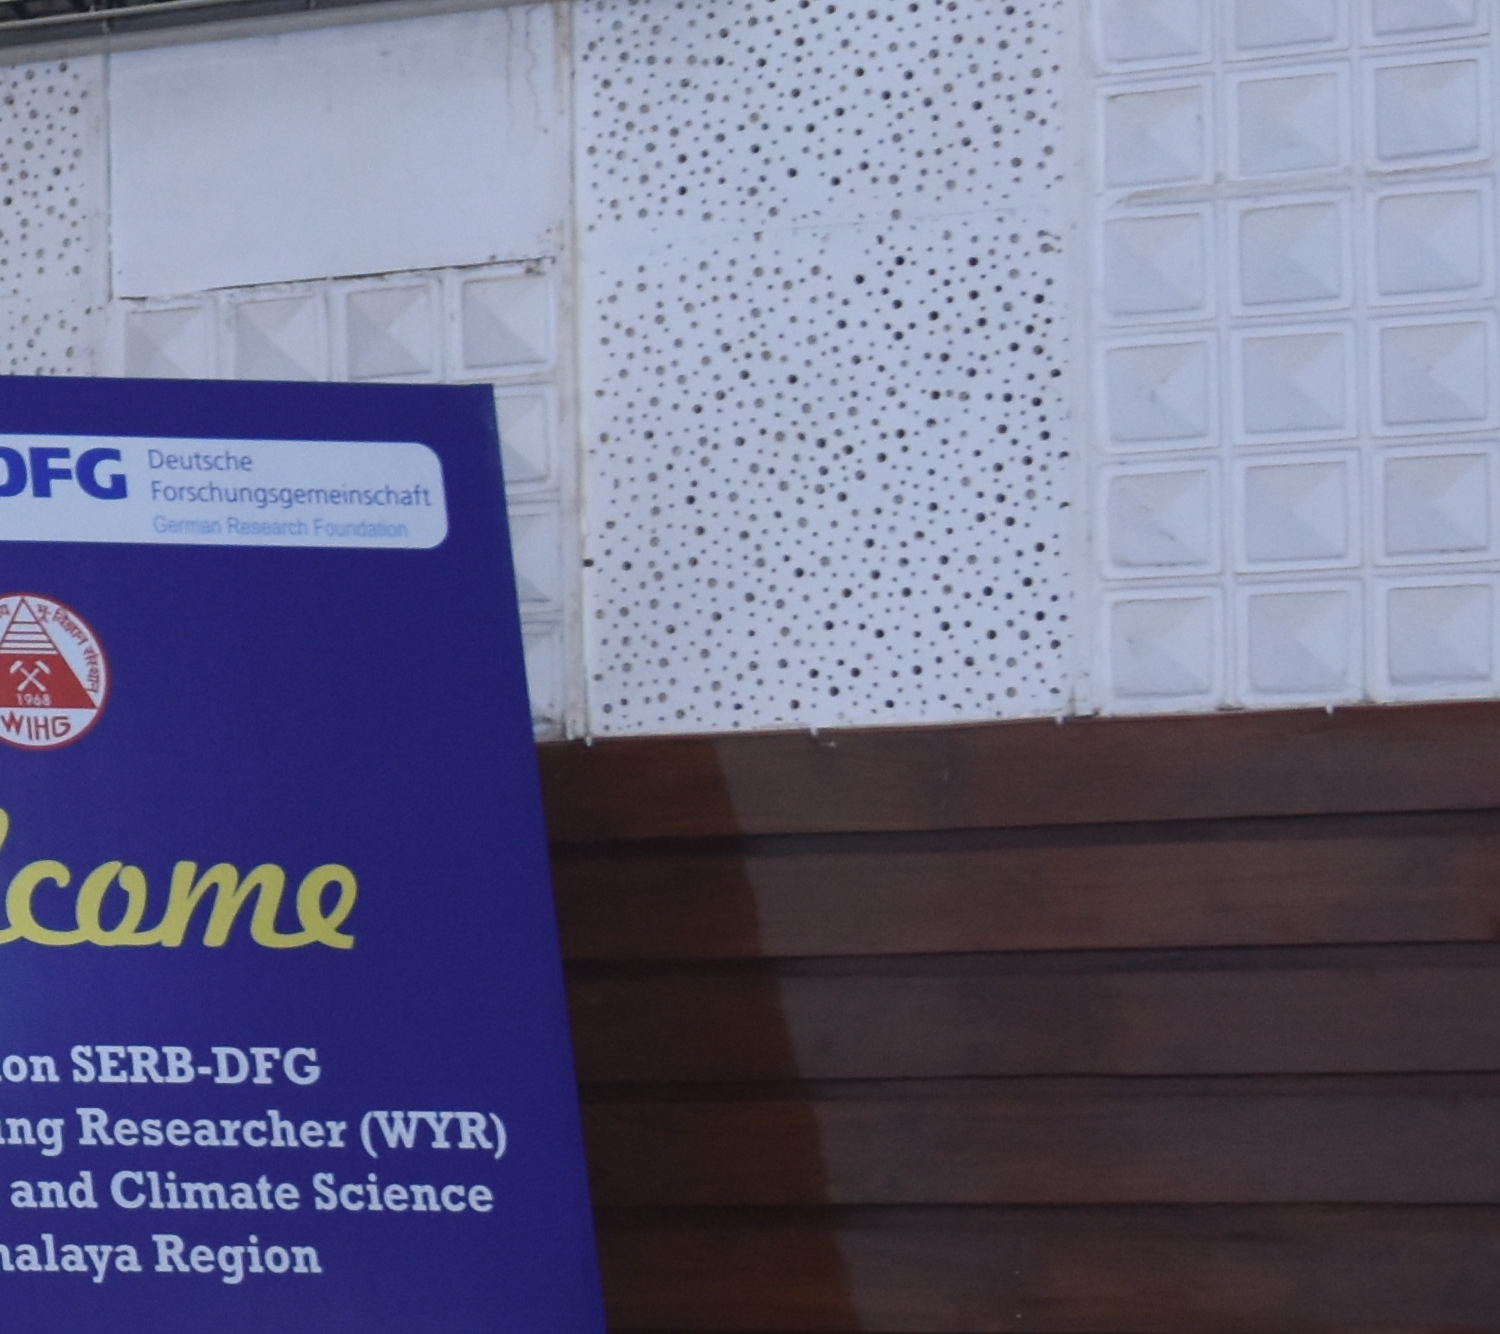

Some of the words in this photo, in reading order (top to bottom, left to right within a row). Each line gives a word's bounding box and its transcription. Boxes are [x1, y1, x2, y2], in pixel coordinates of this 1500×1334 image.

[148, 450, 252, 472] Deutsche
[152, 482, 432, 509] Forschungsgemeinschaft
[153, 515, 221, 535] German
[227, 516, 303, 536] Research
[313, 519, 409, 538] Foundation
[15, 693, 52, 706] 1968
[1, 711, 71, 740] WIHG
[71, 1044, 321, 1085] SERB-DFG
[77, 1108, 346, 1148] Researcher
[361, 1111, 508, 1158] (WYR)
[10, 1169, 97, 1209] and
[109, 1170, 301, 1212] Climate
[312, 1174, 494, 1213] Science
[153, 1235, 323, 1283] Region
